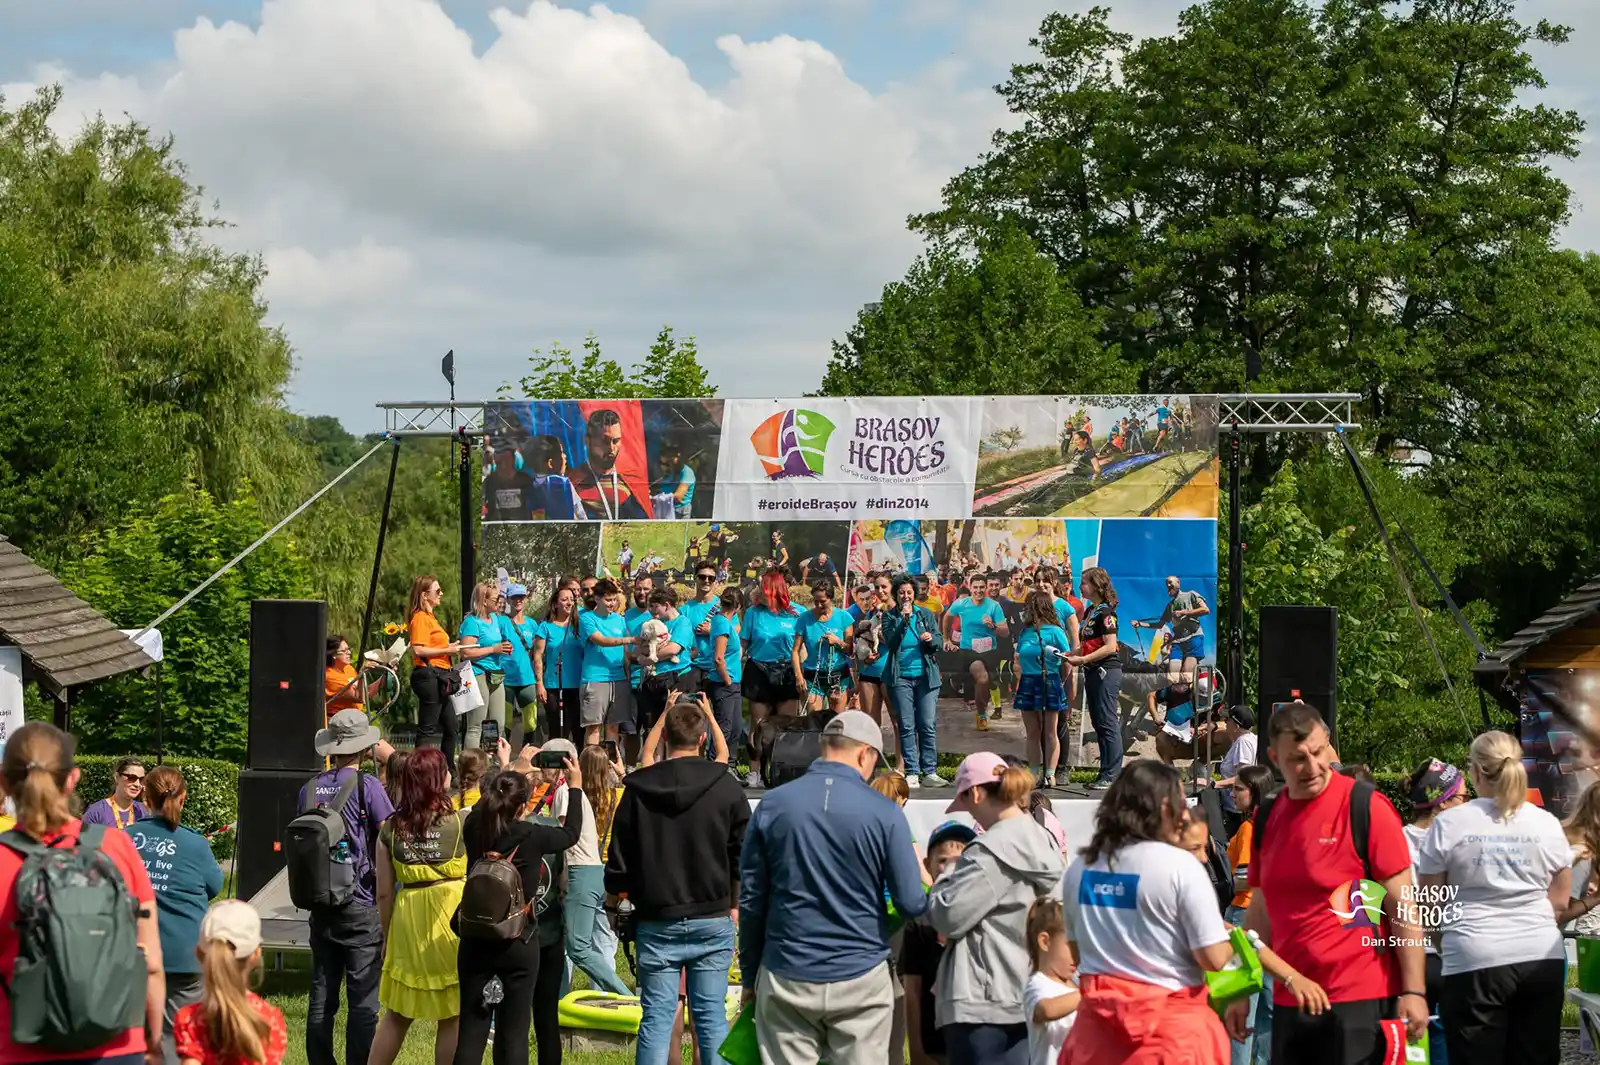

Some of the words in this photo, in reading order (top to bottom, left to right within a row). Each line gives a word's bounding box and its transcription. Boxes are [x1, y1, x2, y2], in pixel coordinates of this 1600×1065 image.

[848, 440, 946, 476] HEROES
[758, 498, 858, 513] #eroideBrașov
[866, 498, 930, 509] #din2014
[155, 859, 173, 870] live
[151, 882, 168, 891] are
